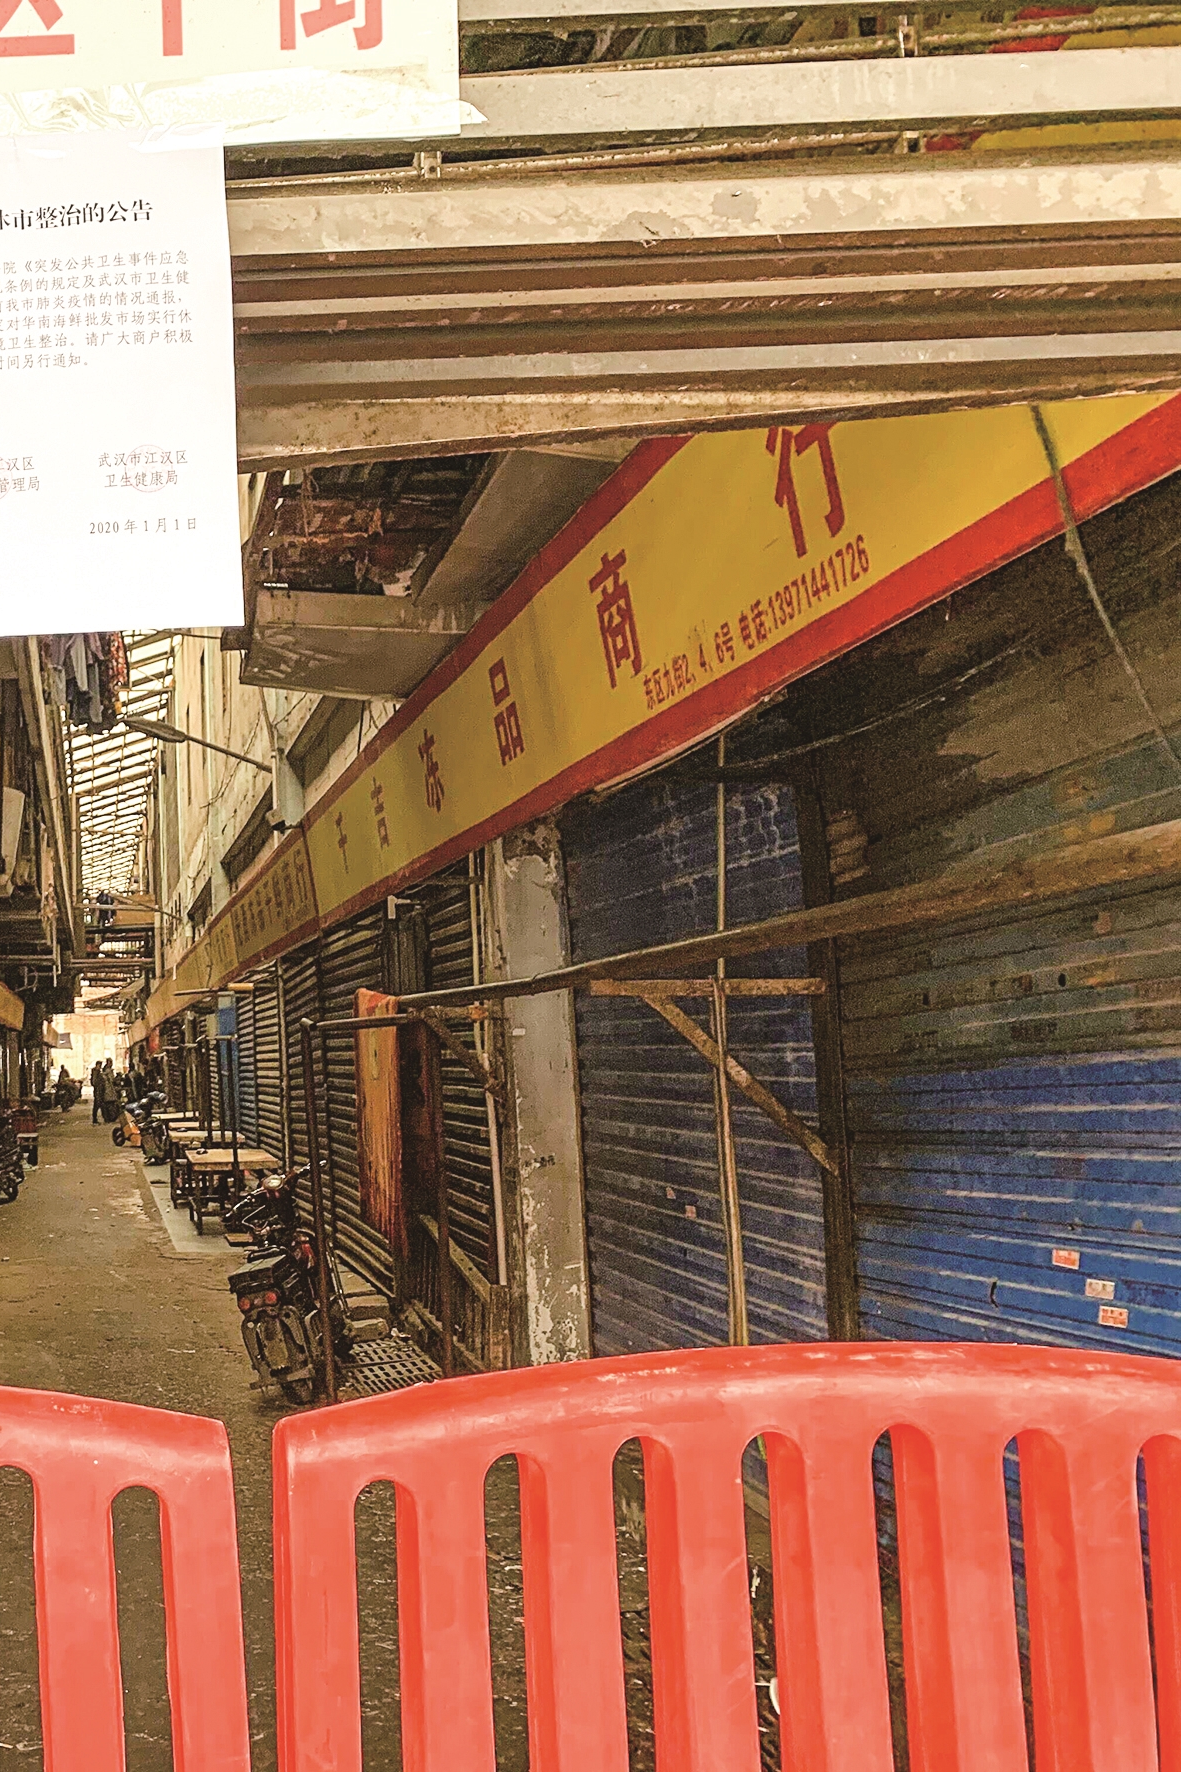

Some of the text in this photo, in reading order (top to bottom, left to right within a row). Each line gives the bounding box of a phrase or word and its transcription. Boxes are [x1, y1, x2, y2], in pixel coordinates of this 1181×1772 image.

[98, 450, 188, 468] 武汉市江汉区
[104, 470, 178, 488] 卫生健康局
